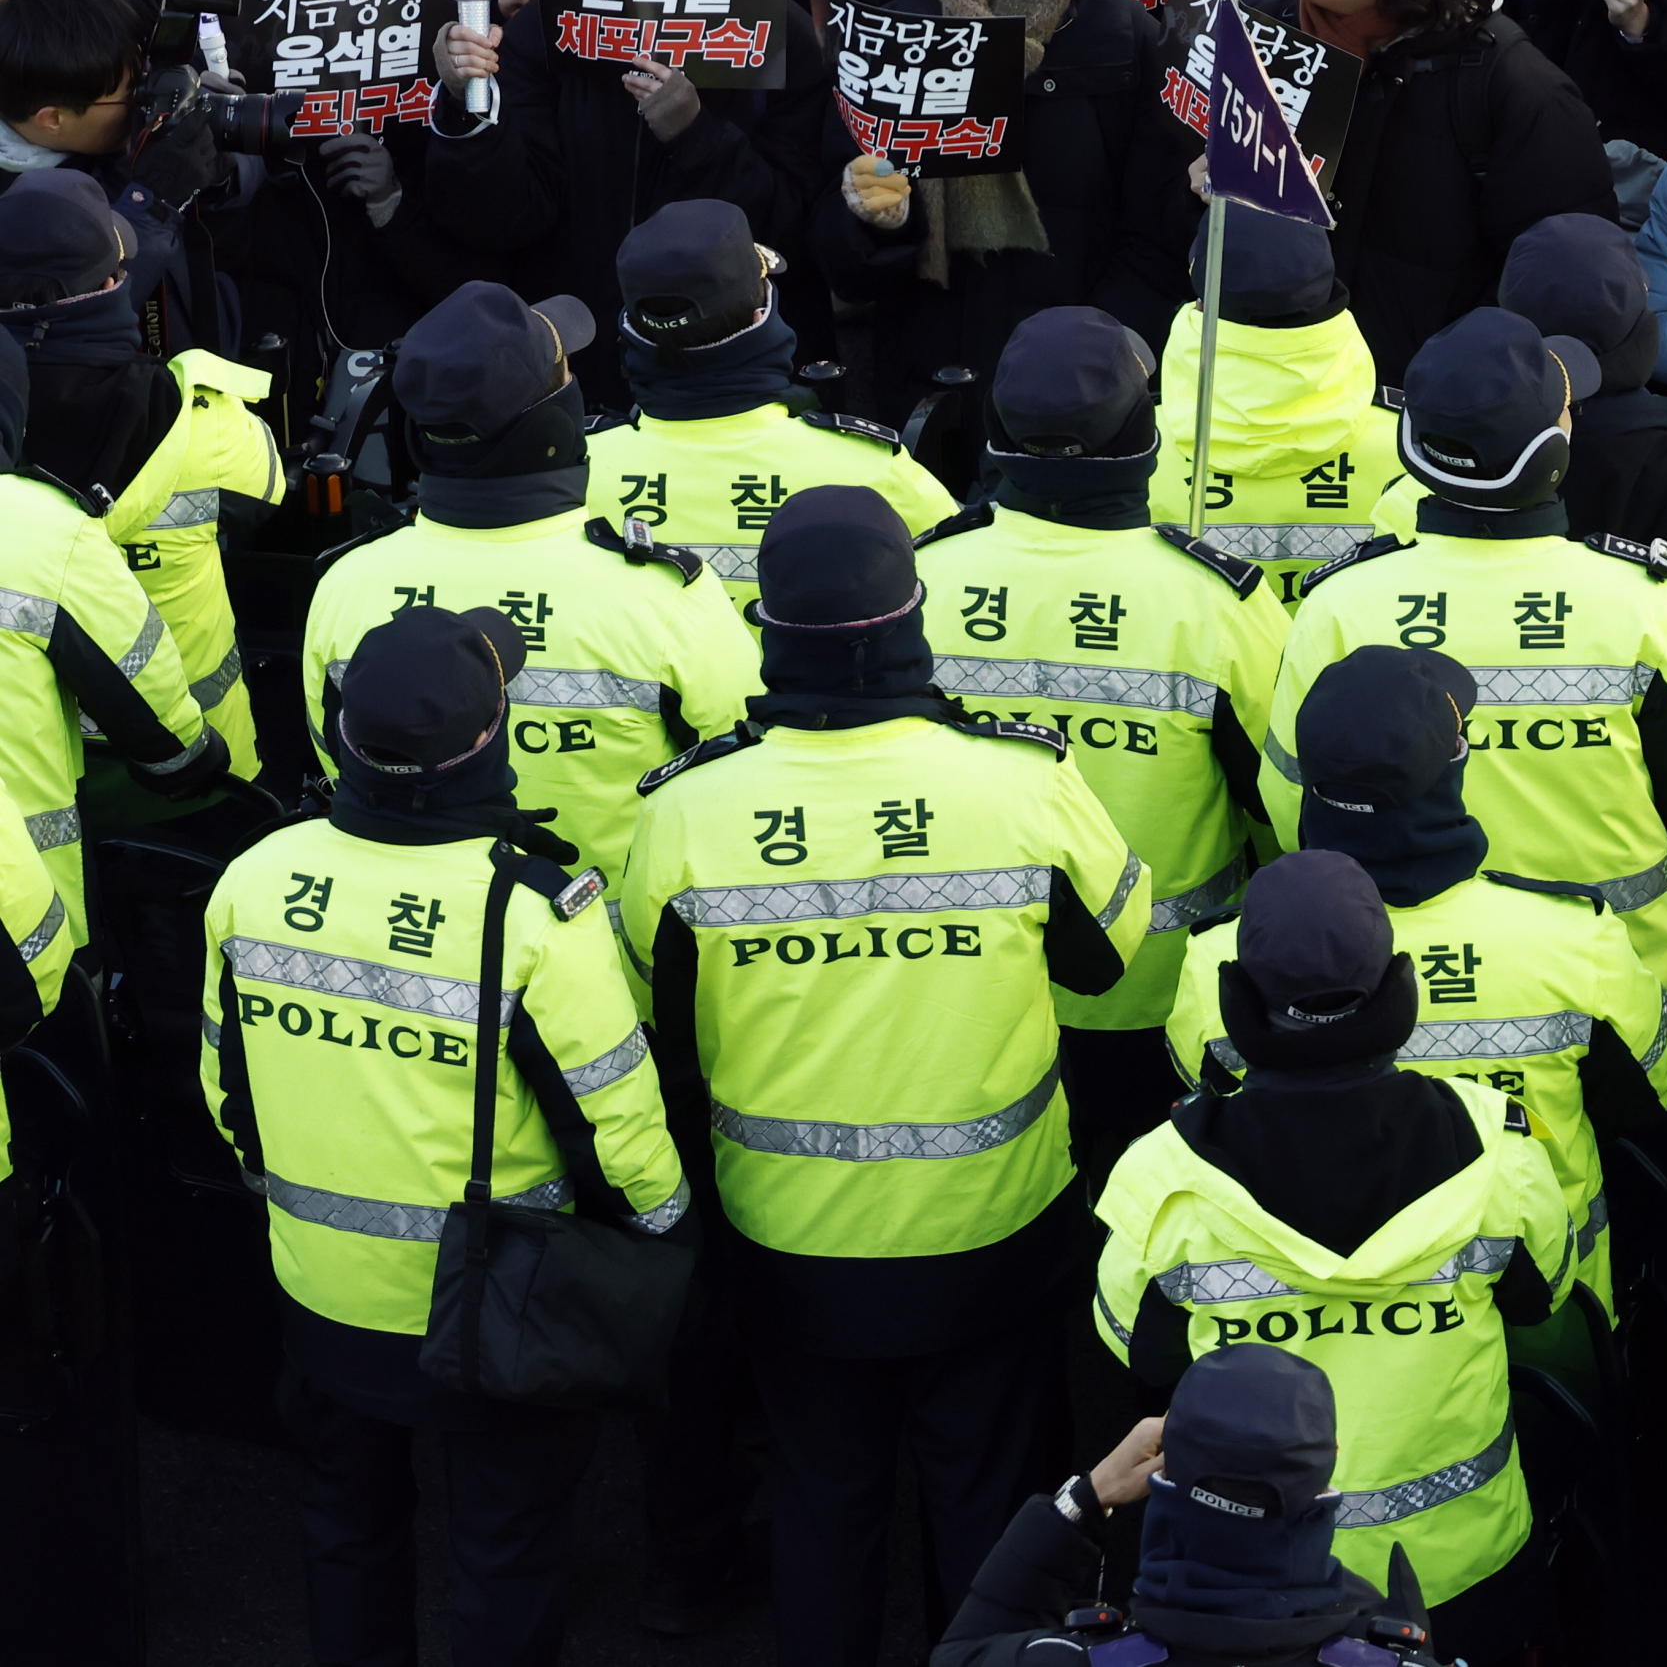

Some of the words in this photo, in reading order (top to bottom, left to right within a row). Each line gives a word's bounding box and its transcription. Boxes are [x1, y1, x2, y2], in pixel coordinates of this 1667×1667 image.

[272, 25, 423, 82] 윤석열
[556, 12, 773, 68] 체포!구속!
[825, 0, 988, 69] 지금당장
[837, 46, 973, 116] 윤석열
[288, 85, 434, 139] 포!구속
[832, 88, 1006, 161] 체포!구속!
[1218, 72, 1288, 198] 75기-1
[1422, 442, 1475, 469] POLICE
[1460, 717, 1612, 751] LICE
[730, 923, 983, 969] POLICE
[236, 992, 471, 1070] POLICE
[1286, 1005, 1359, 1024] POLICE
[1191, 1486, 1266, 1520] POLICE
